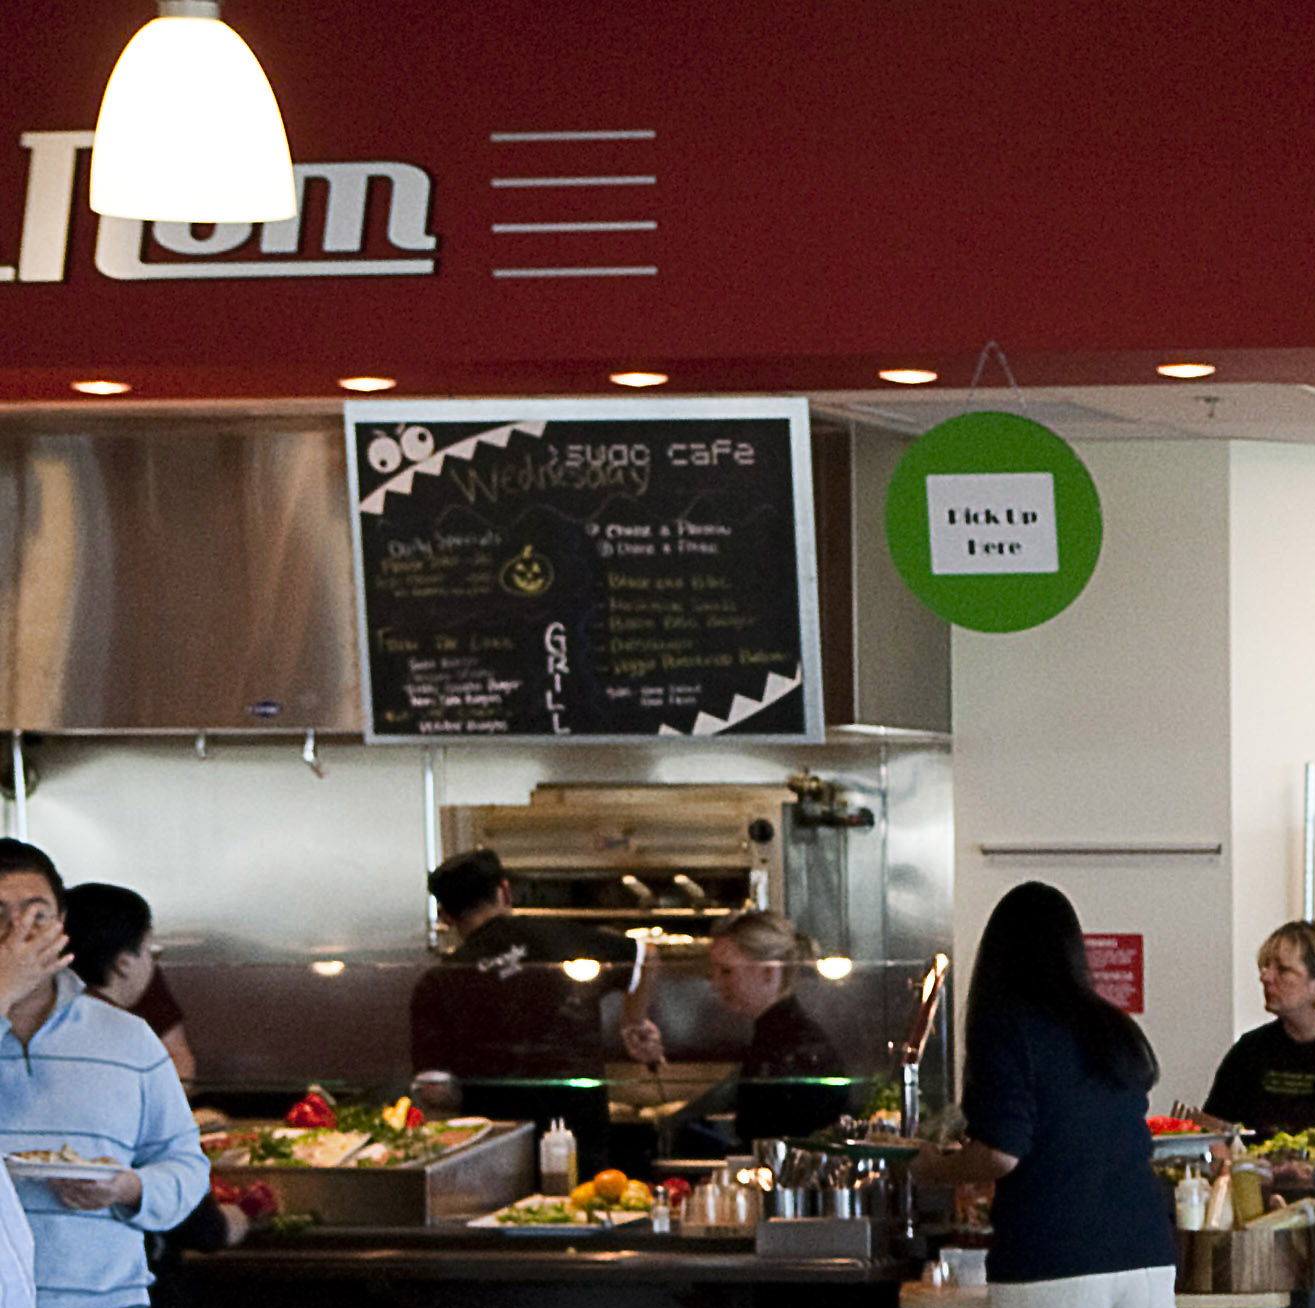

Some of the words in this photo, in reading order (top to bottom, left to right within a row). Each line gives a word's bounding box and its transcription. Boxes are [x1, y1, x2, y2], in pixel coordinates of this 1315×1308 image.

[948, 508, 1000, 525] Pick
[1006, 508, 1037, 525] Up
[967, 538, 1022, 556] Here
[545, 622, 571, 734] GRILL
